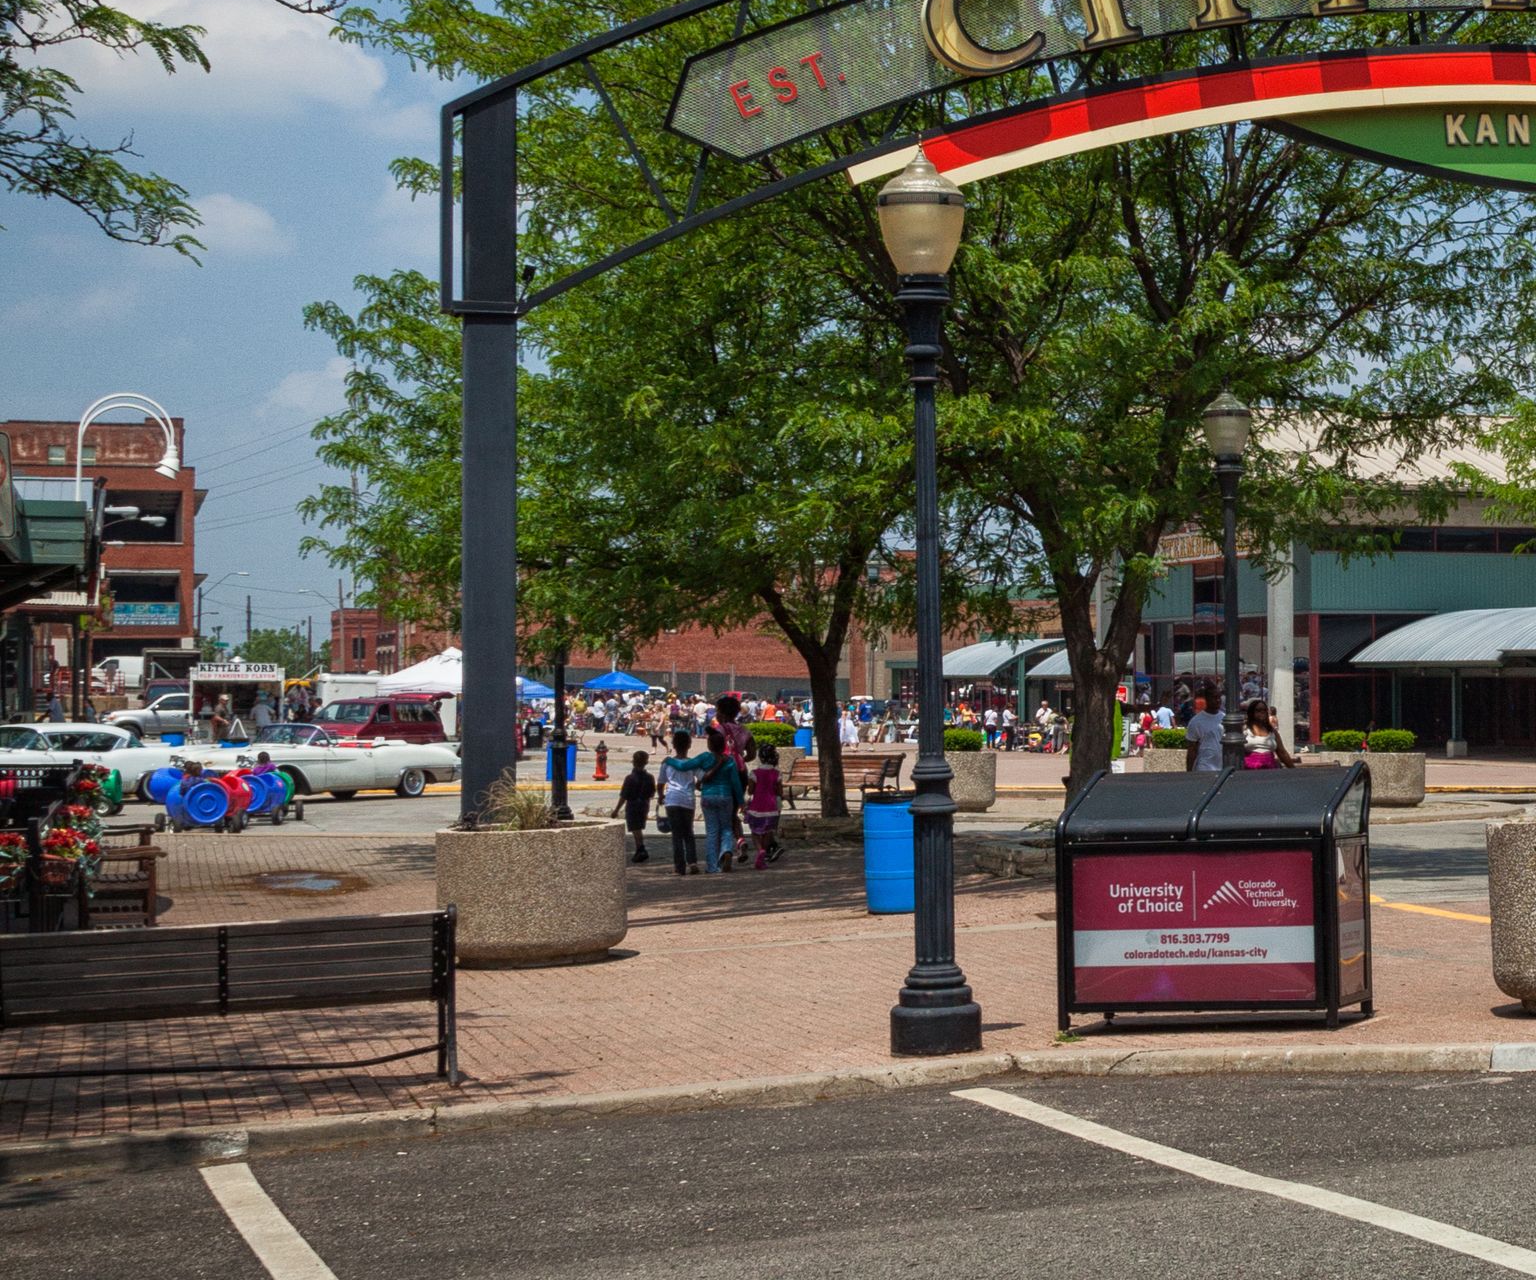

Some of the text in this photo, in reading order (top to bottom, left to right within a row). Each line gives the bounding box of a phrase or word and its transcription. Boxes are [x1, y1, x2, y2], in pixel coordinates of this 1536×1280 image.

[728, 51, 846, 119] EST.
[199, 663, 276, 673] KETTLE KORN
[1238, 879, 1277, 889] Colorado
[1109, 882, 1184, 899] University
[1245, 889, 1284, 898] Technical
[1118, 899, 1184, 913] of Choice
[1160, 933, 1230, 945] 816.303.7799
[1123, 947, 1268, 960] coloradotech.edu/kansas-city
